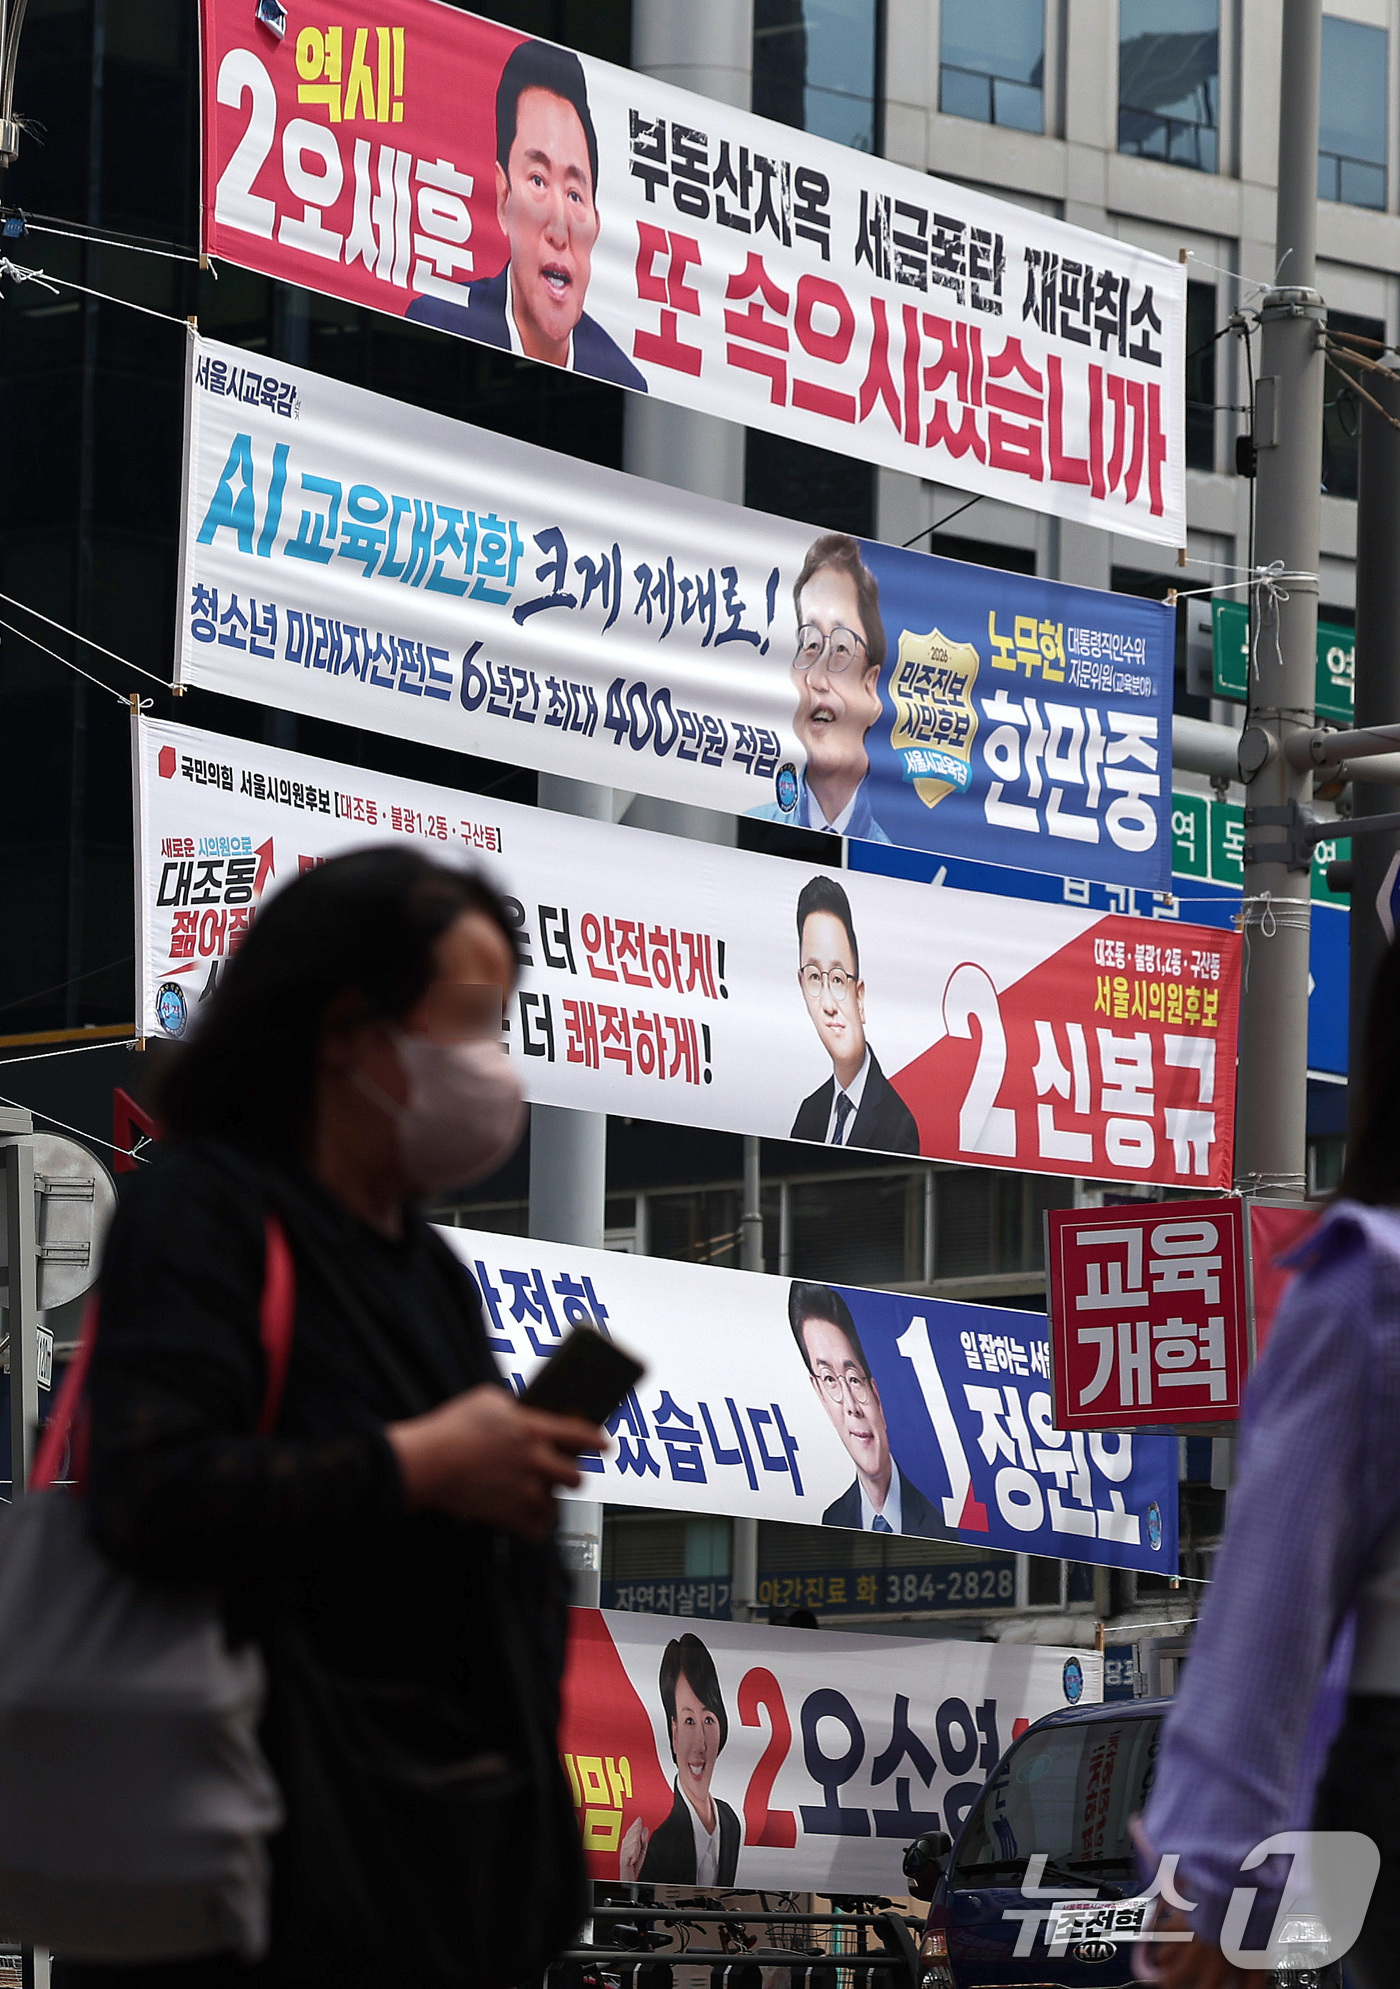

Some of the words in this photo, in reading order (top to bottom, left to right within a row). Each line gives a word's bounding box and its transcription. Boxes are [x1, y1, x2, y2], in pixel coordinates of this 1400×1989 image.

[295, 26, 405, 123] 역시!
[215, 48, 278, 240] 2
[278, 118, 474, 308] 오세훈
[629, 108, 831, 262] 부동산지옥
[855, 189, 1005, 316] 세금폭탄
[1022, 246, 1163, 368] 재판취소
[195, 354, 297, 419] 서울시교육감
[633, 219, 703, 378] 또
[723, 251, 1167, 517] 속으시겠습니까
[196, 432, 290, 558] AI
[284, 472, 525, 606] 교육대전환
[512, 525, 622, 635] 크게
[633, 555, 780, 656] 제대로!
[190, 582, 277, 660] 청소년
[284, 610, 454, 702] 미래자산펀드
[459, 640, 543, 725] 6년간
[543, 675, 598, 738] 최대
[602, 677, 729, 768] 400만원
[731, 722, 782, 779] 적립
[897, 660, 970, 710] 민주진보
[988, 610, 1067, 683] 노무현
[1067, 626, 1146, 666] 대통령직인수위
[899, 701, 970, 749] 시민후보
[981, 688, 1161, 852] 한만중
[181, 755, 234, 792] 국민의힘
[240, 770, 331, 815] 서울시의원후보
[156, 857, 257, 907] 대조동
[161, 837, 195, 858] 새로운
[199, 836, 254, 857] 시의원으로
[538, 904, 577, 975] 더
[580, 912, 729, 1000] 안전하게!
[1094, 938, 1126, 970] 대조동
[1190, 950, 1221, 980] 구산동
[518, 991, 555, 1062] 더
[562, 998, 713, 1085] 쾌적하게!
[1094, 975, 1219, 1027] 서울시의원후보
[943, 961, 1017, 1158] 2
[1031, 1019, 1217, 1176] 신봉규
[1075, 1220, 1223, 1311] 교육
[1077, 1316, 1228, 1407] 개혁
[896, 1315, 990, 1533] 1
[760, 1577, 848, 1607] 야간진료
[856, 1575, 878, 1606] 화
[886, 1570, 1014, 1603] 384-2828
[737, 1666, 797, 1849] 2
[798, 1686, 1000, 1841] 오소영
[1055, 1908, 1145, 1939] 조전혁
[1080, 1943, 1109, 1959] KIA
